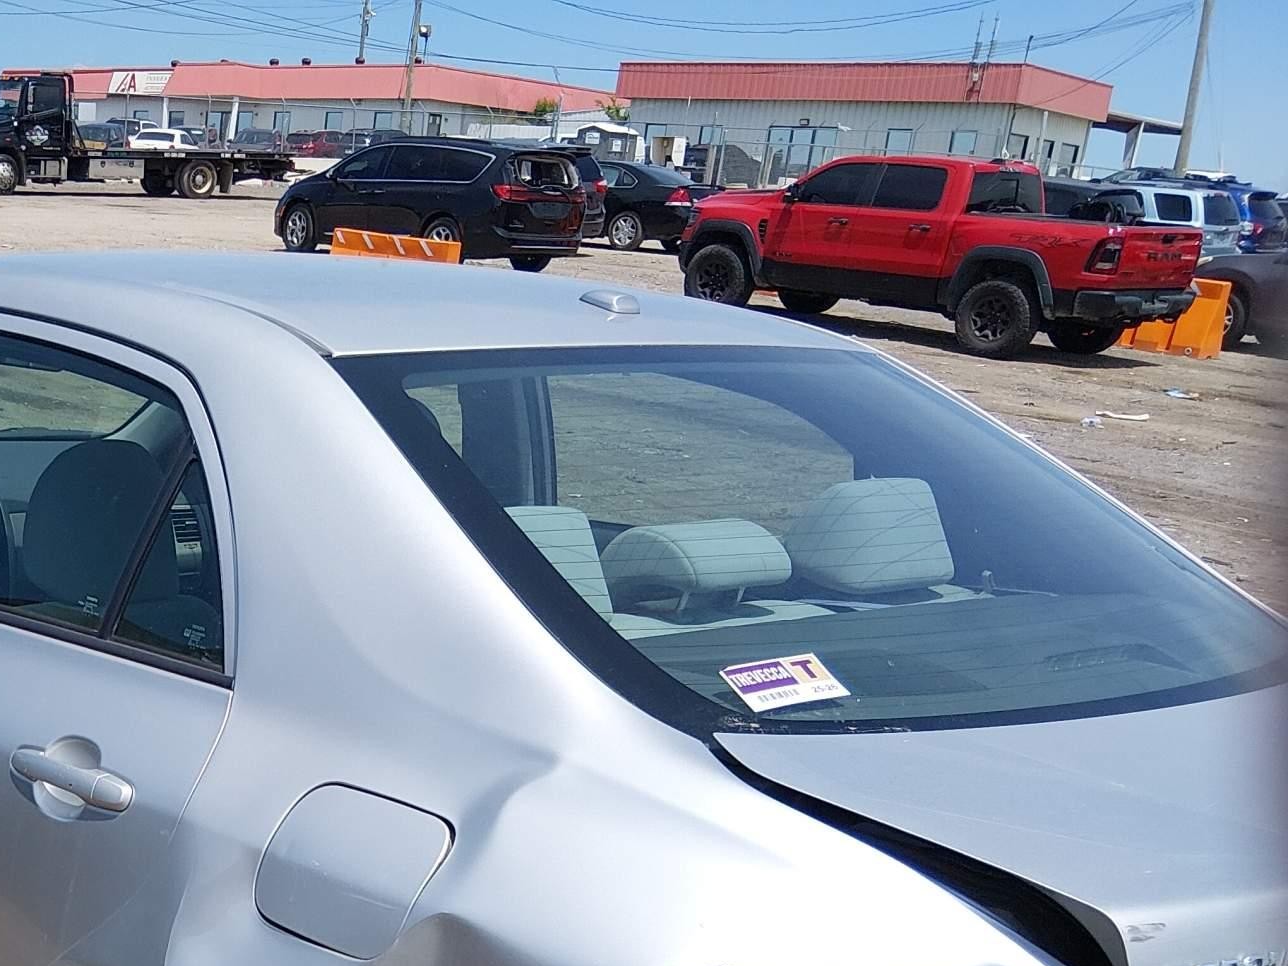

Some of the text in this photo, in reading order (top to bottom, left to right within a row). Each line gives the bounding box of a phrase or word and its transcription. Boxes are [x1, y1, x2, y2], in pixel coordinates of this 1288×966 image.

[1147, 251, 1182, 262] RAM
[728, 658, 818, 688] TREVECCA T
